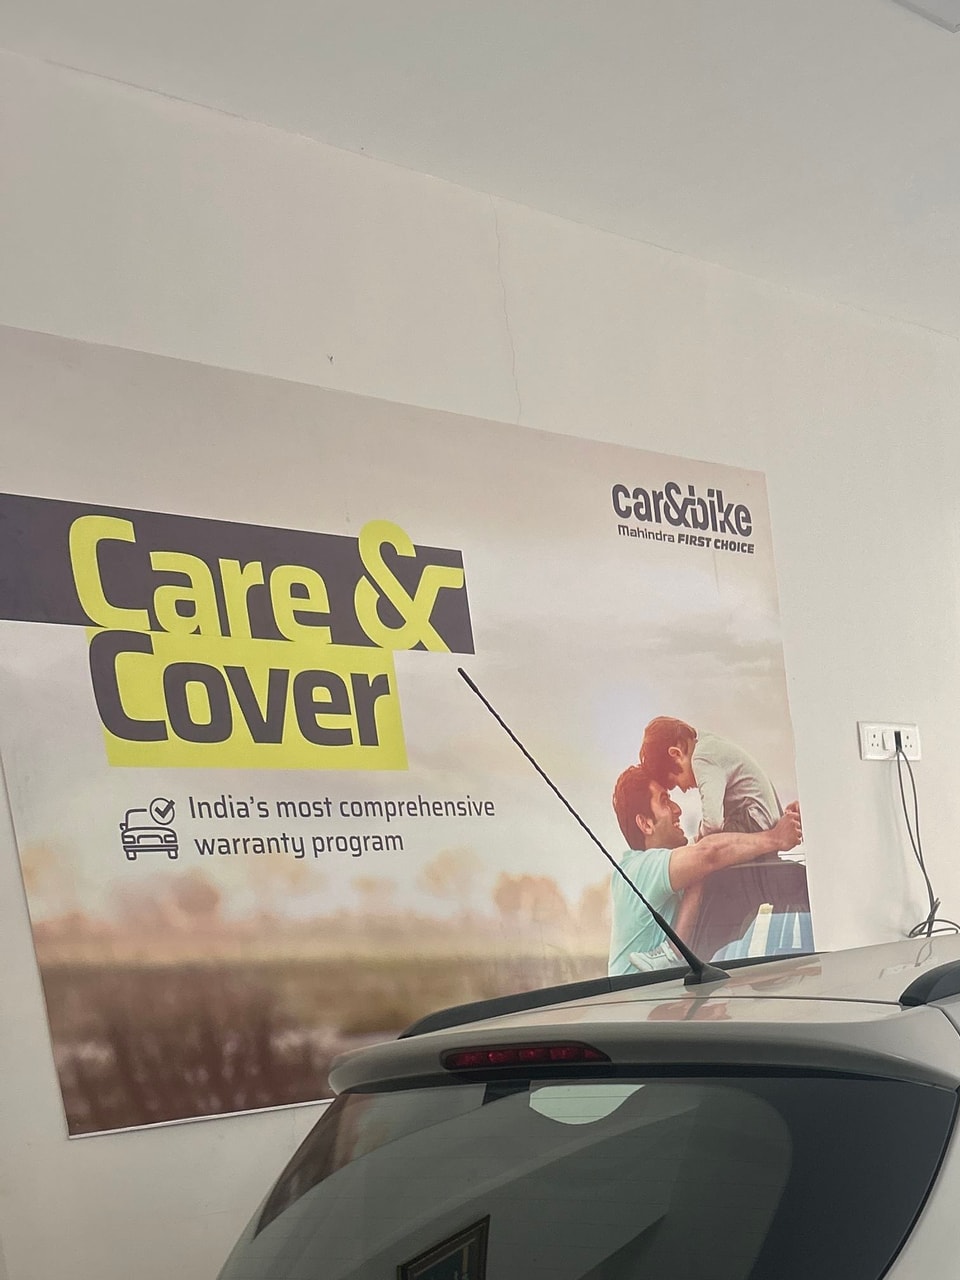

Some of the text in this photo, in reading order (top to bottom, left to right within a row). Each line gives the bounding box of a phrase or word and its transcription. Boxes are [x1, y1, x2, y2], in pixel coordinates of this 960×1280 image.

[617, 524, 755, 554] Mahindra FIRST CHOICE
[68, 514, 465, 652] Care &
[89, 628, 391, 747] Cover
[276, 797, 332, 818] most
[339, 794, 496, 822] comprehensive
[194, 833, 404, 859] warranty program
